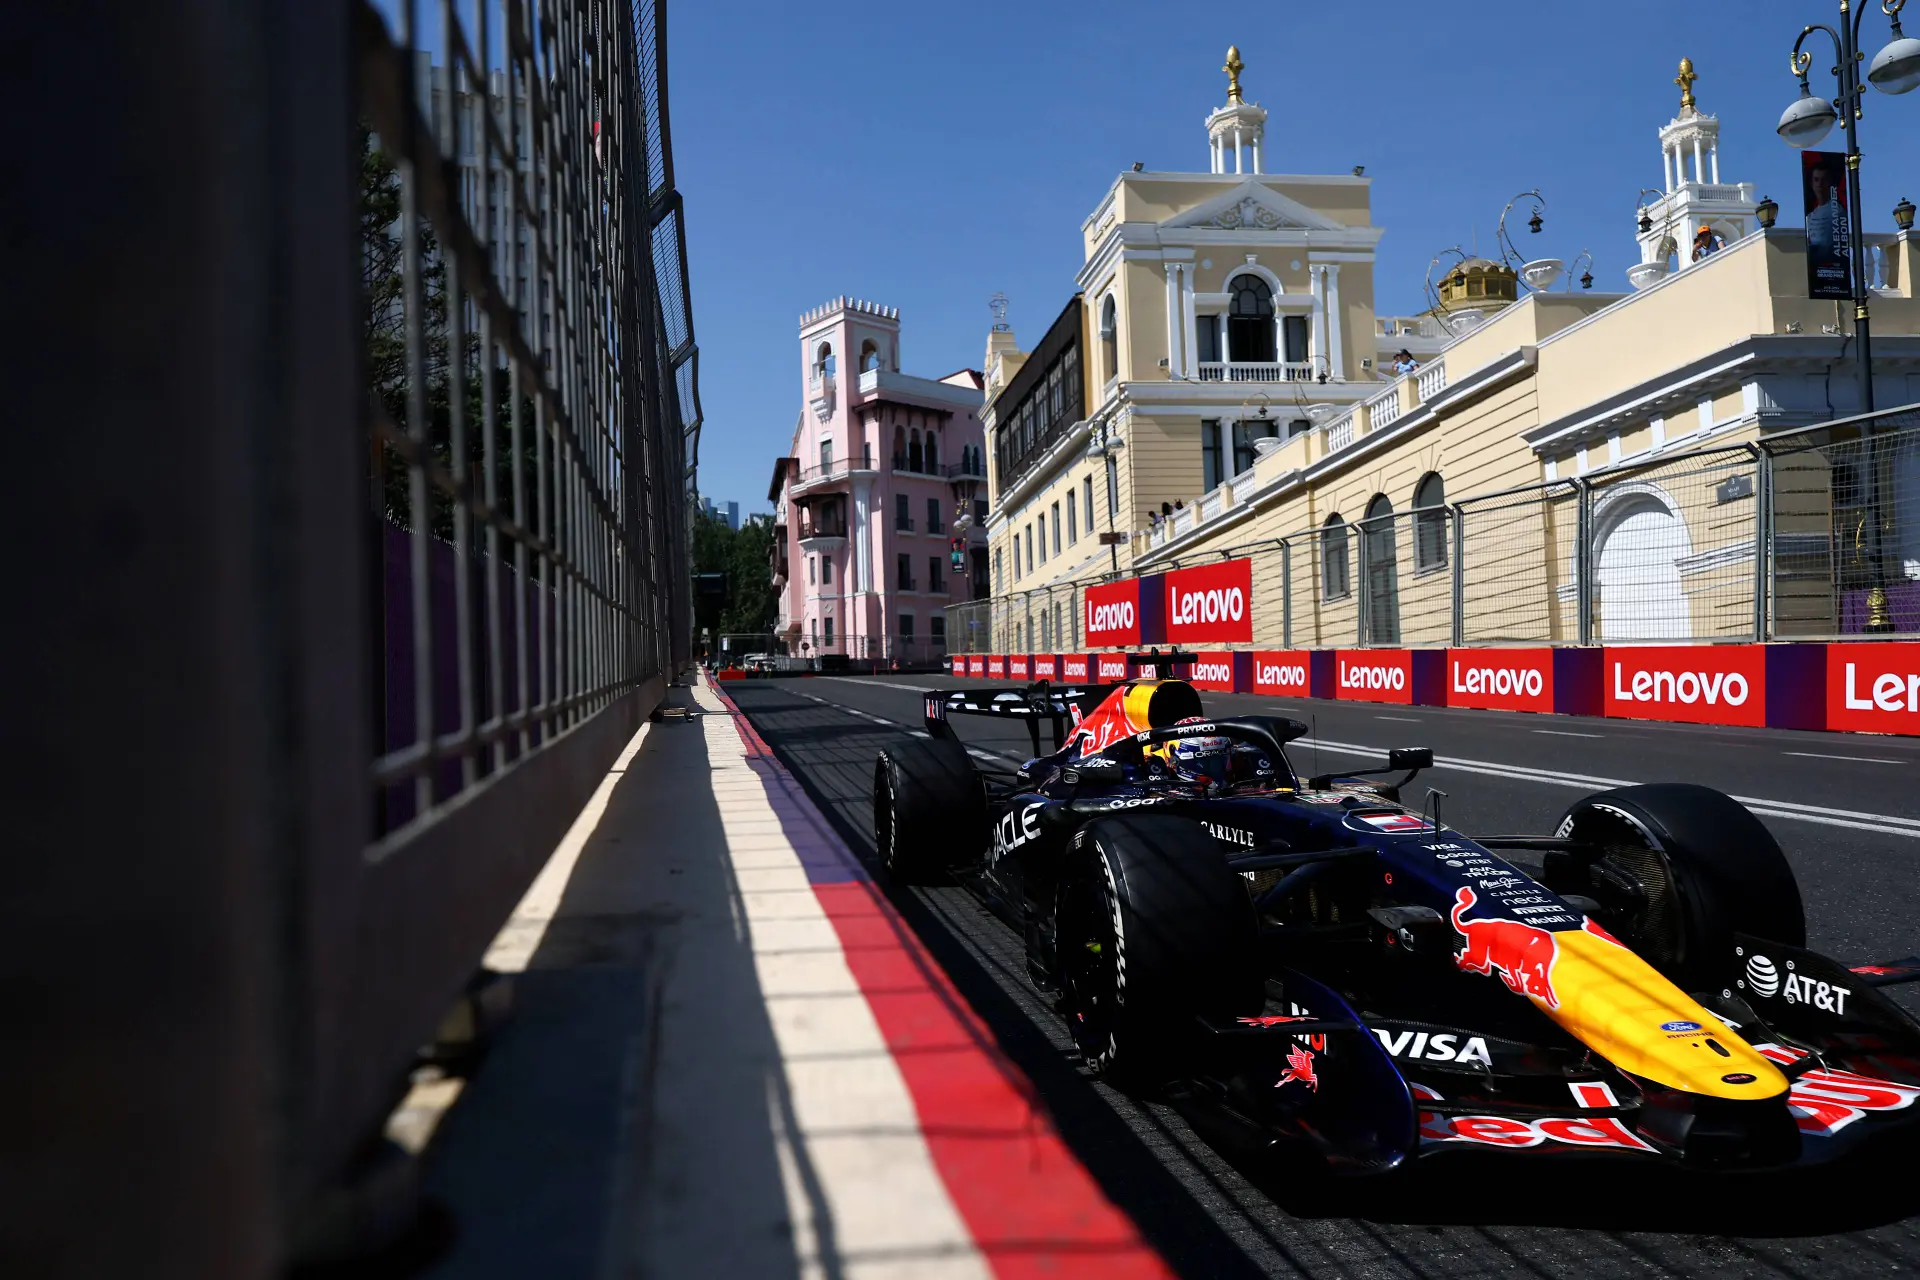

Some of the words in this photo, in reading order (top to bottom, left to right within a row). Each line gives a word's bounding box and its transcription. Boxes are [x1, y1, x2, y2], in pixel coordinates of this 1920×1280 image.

[1830, 186, 1841, 257] ALEXANDER
[1840, 216, 1850, 258] ALBON
[1171, 586, 1243, 625] Lenovo
[1088, 600, 1134, 632] Lenovo
[1010, 660, 1027, 674] Lenovo
[1035, 660, 1054, 675] Lenovo
[1064, 660, 1086, 676] Lenovo
[1098, 660, 1125, 677] Lenovo
[1140, 664, 1157, 678] Len
[1191, 663, 1230, 682] Lenovo
[1256, 661, 1305, 686] Lenovo
[1340, 661, 1405, 690] Lenovo
[1453, 661, 1543, 697] Lenovo
[1614, 662, 1749, 706] Lenovo
[1137, 731, 1151, 742] VISA
[1177, 724, 1216, 734] PRYPCO
[992, 802, 1046, 869] ACLE
[1490, 889, 1541, 897] CARLYLE
[1511, 905, 1566, 914] PIRELLI
[1524, 915, 1565, 925] Mobil
[1783, 973, 1851, 1015] AT&T
[1666, 1031, 1715, 1039] RACING
[1668, 1022, 1695, 1031] Ford
[1371, 1028, 1493, 1065] VISA
